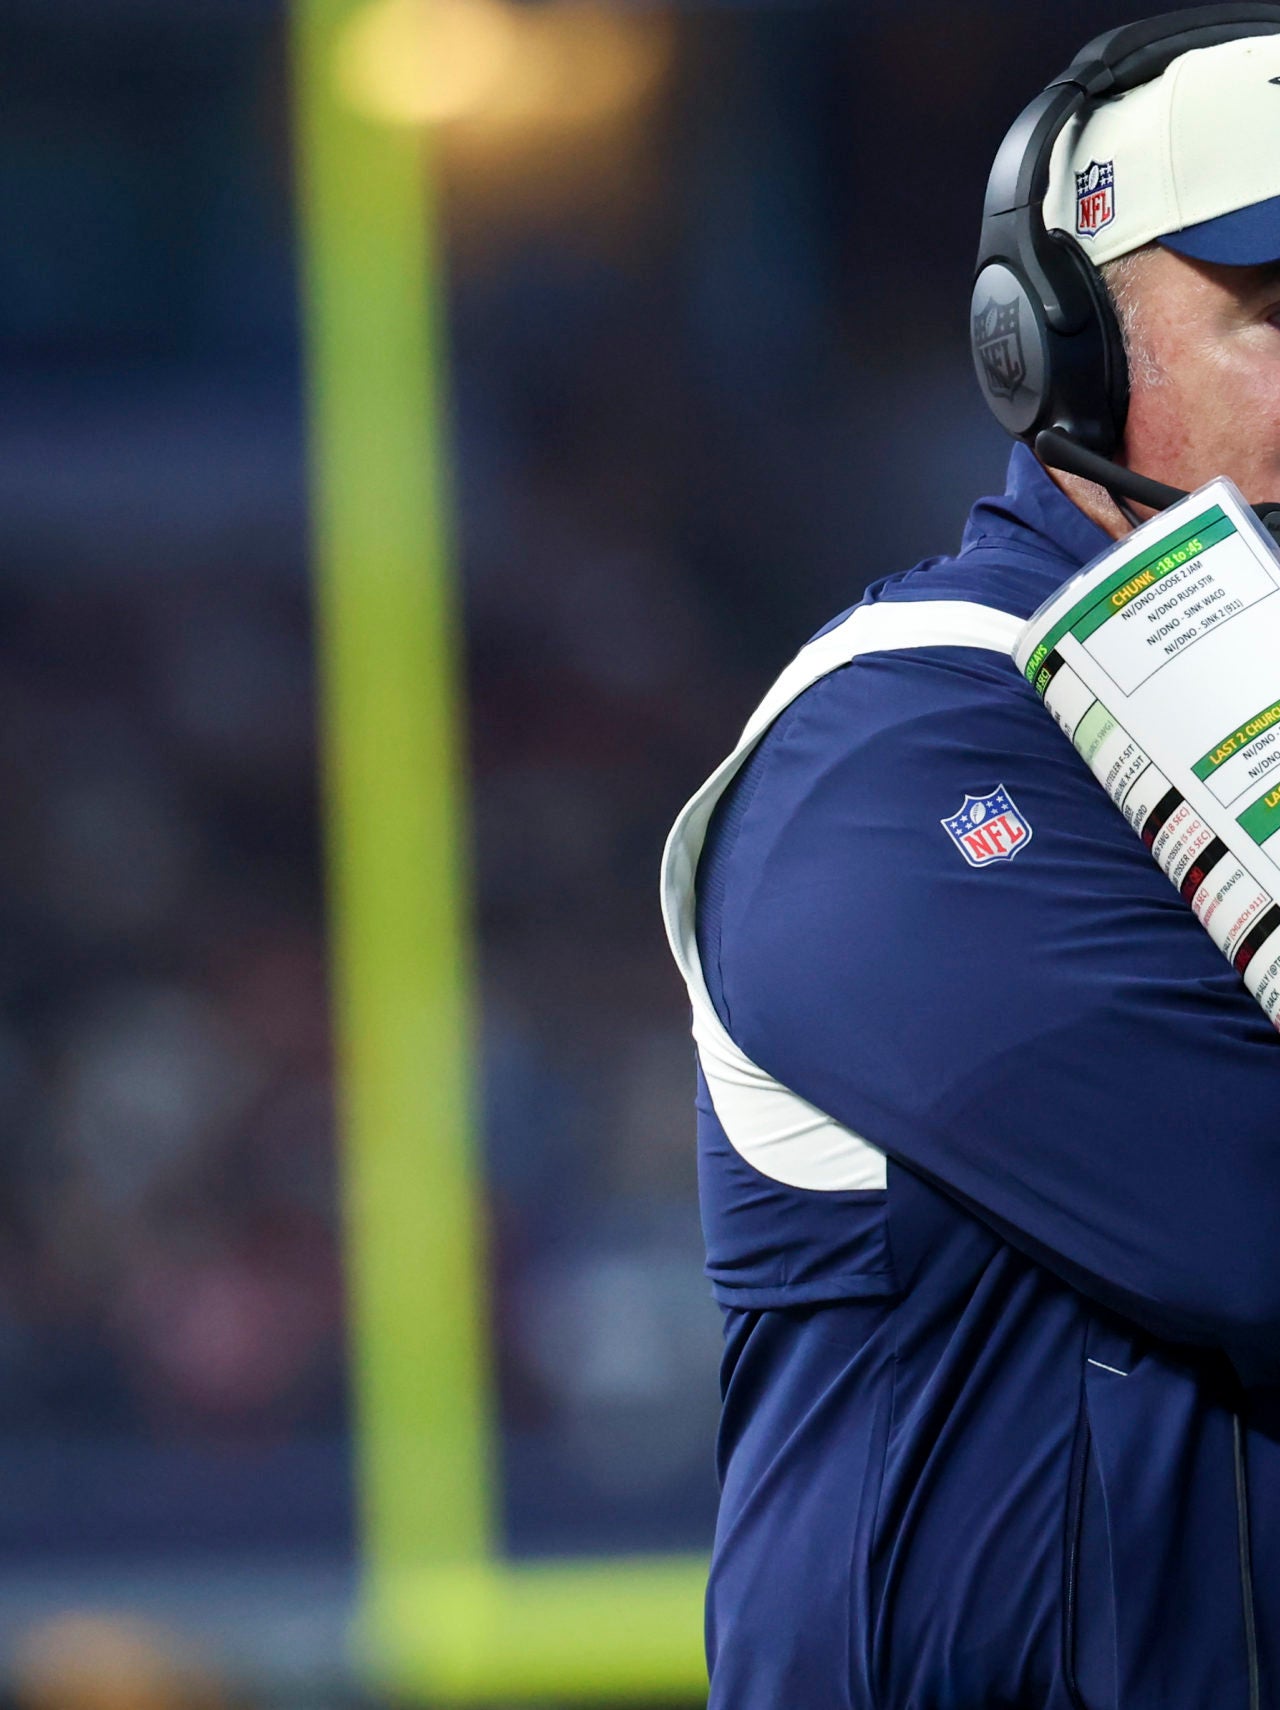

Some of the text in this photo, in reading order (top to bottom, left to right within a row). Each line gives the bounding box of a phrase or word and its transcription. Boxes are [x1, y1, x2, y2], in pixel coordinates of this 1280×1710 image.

[1079, 191, 1111, 229] NFL
[982, 339, 1022, 389] NFL
[1109, 538, 1204, 607] CHUNK :18 to :45
[1185, 559, 1204, 574] JAM
[1176, 582, 1199, 601] RUSH
[1196, 573, 1214, 587] STIR
[1145, 587, 1226, 645] NI/DNO SINK WACO
[1163, 597, 1243, 654] NI/DNO SINK (911)
[1027, 643, 1049, 670] PLAYS
[1117, 743, 1135, 765] F-SIT
[1208, 738, 1238, 765] LAST
[1241, 732, 1276, 760] NI/DNO
[1123, 755, 1145, 781] X-4 SIT
[964, 816, 1024, 859] NFL
[1156, 830, 1171, 848] SWG
[1171, 806, 1190, 826] SEC)
[1192, 829, 1211, 848] SEC)
